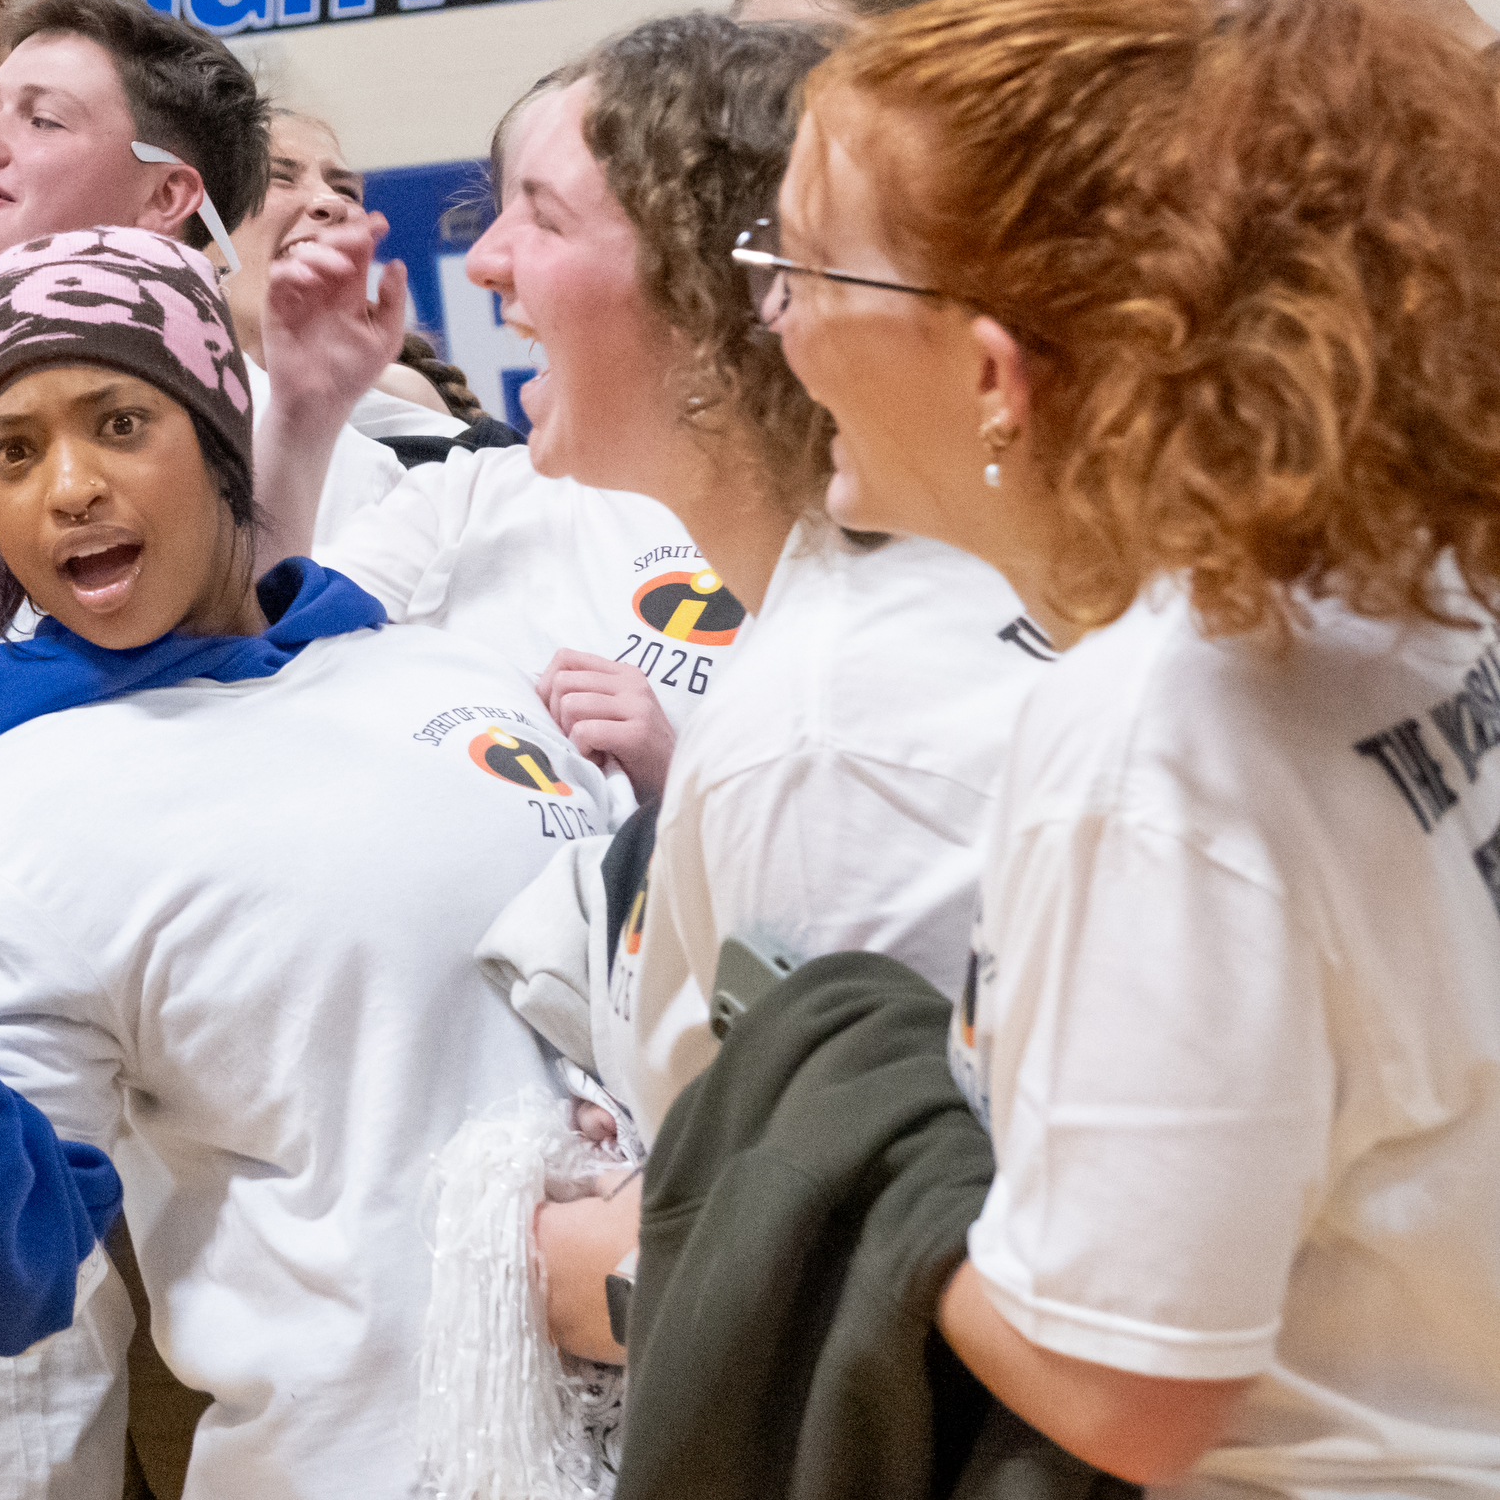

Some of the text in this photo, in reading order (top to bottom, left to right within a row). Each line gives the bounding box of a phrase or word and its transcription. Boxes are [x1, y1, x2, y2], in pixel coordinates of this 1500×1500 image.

[633, 545, 693, 572] SPIRIT
[615, 634, 713, 695] 2026
[413, 711, 461, 746] SPIRIT
[452, 706, 477, 721] OF
[473, 706, 512, 720] THE
